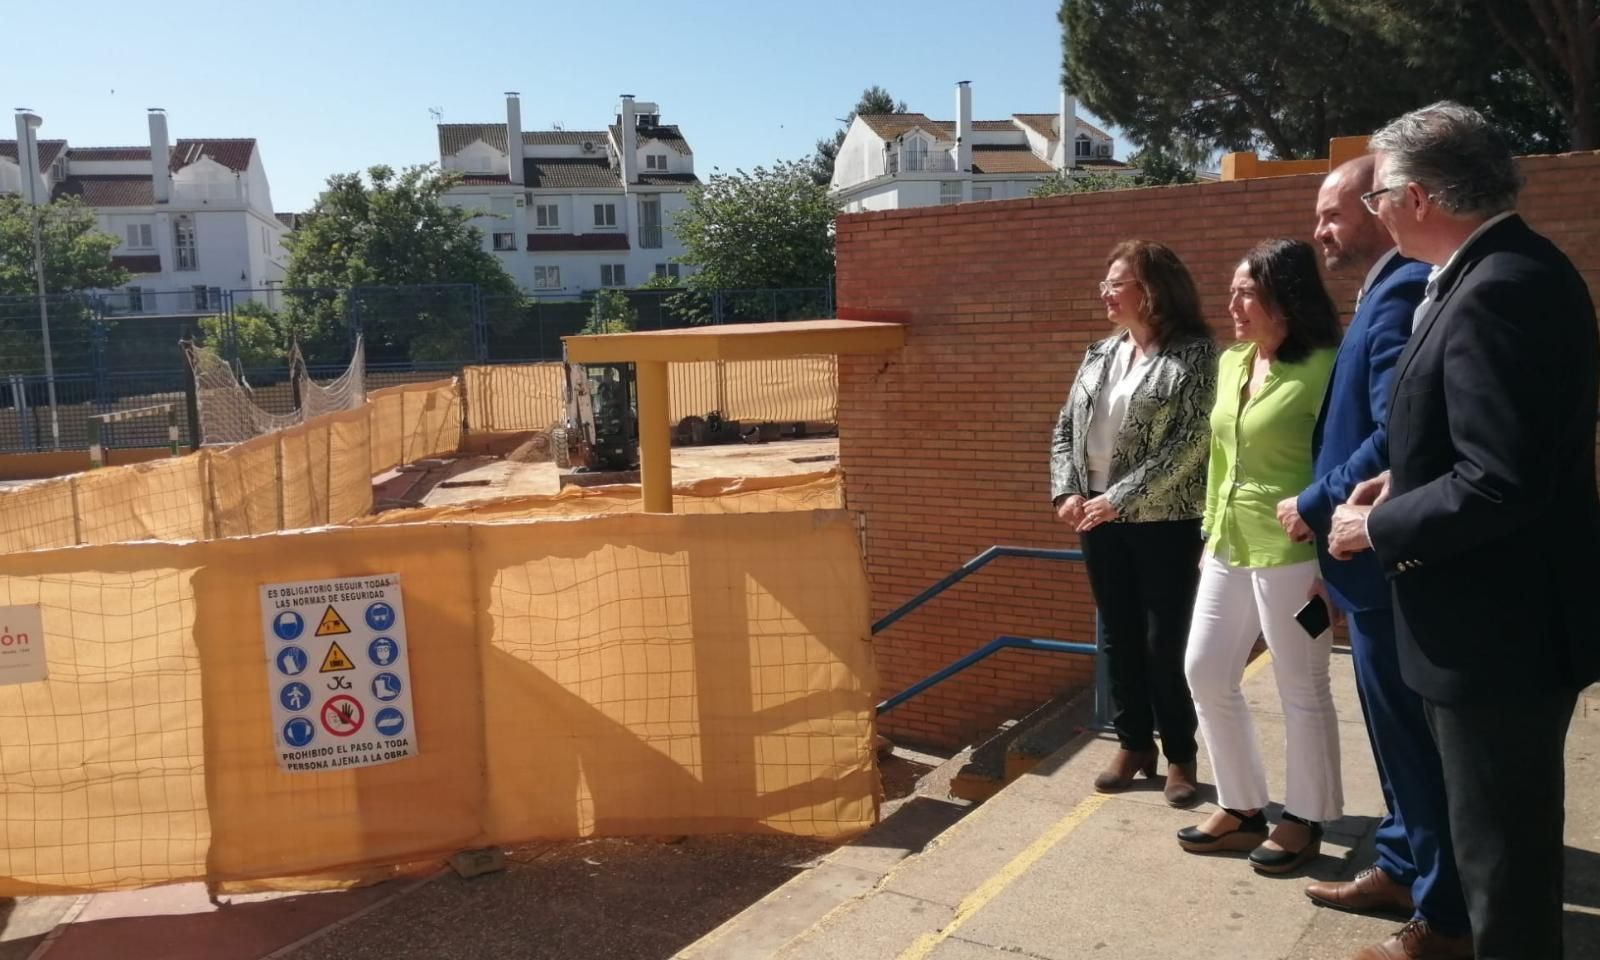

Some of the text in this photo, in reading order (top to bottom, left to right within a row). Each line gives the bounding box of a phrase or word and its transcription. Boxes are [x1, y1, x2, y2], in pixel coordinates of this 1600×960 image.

[267, 578, 391, 598] ES OBLIGATORIO SEGUIR TODAS
[275, 590, 385, 608] LAS NORMAS DE SEGURIDAD
[282, 738, 408, 760] PROHIBIDO EL PASO A TODA
[287, 749, 409, 771] PERSONA AJENA A LA OBRA
